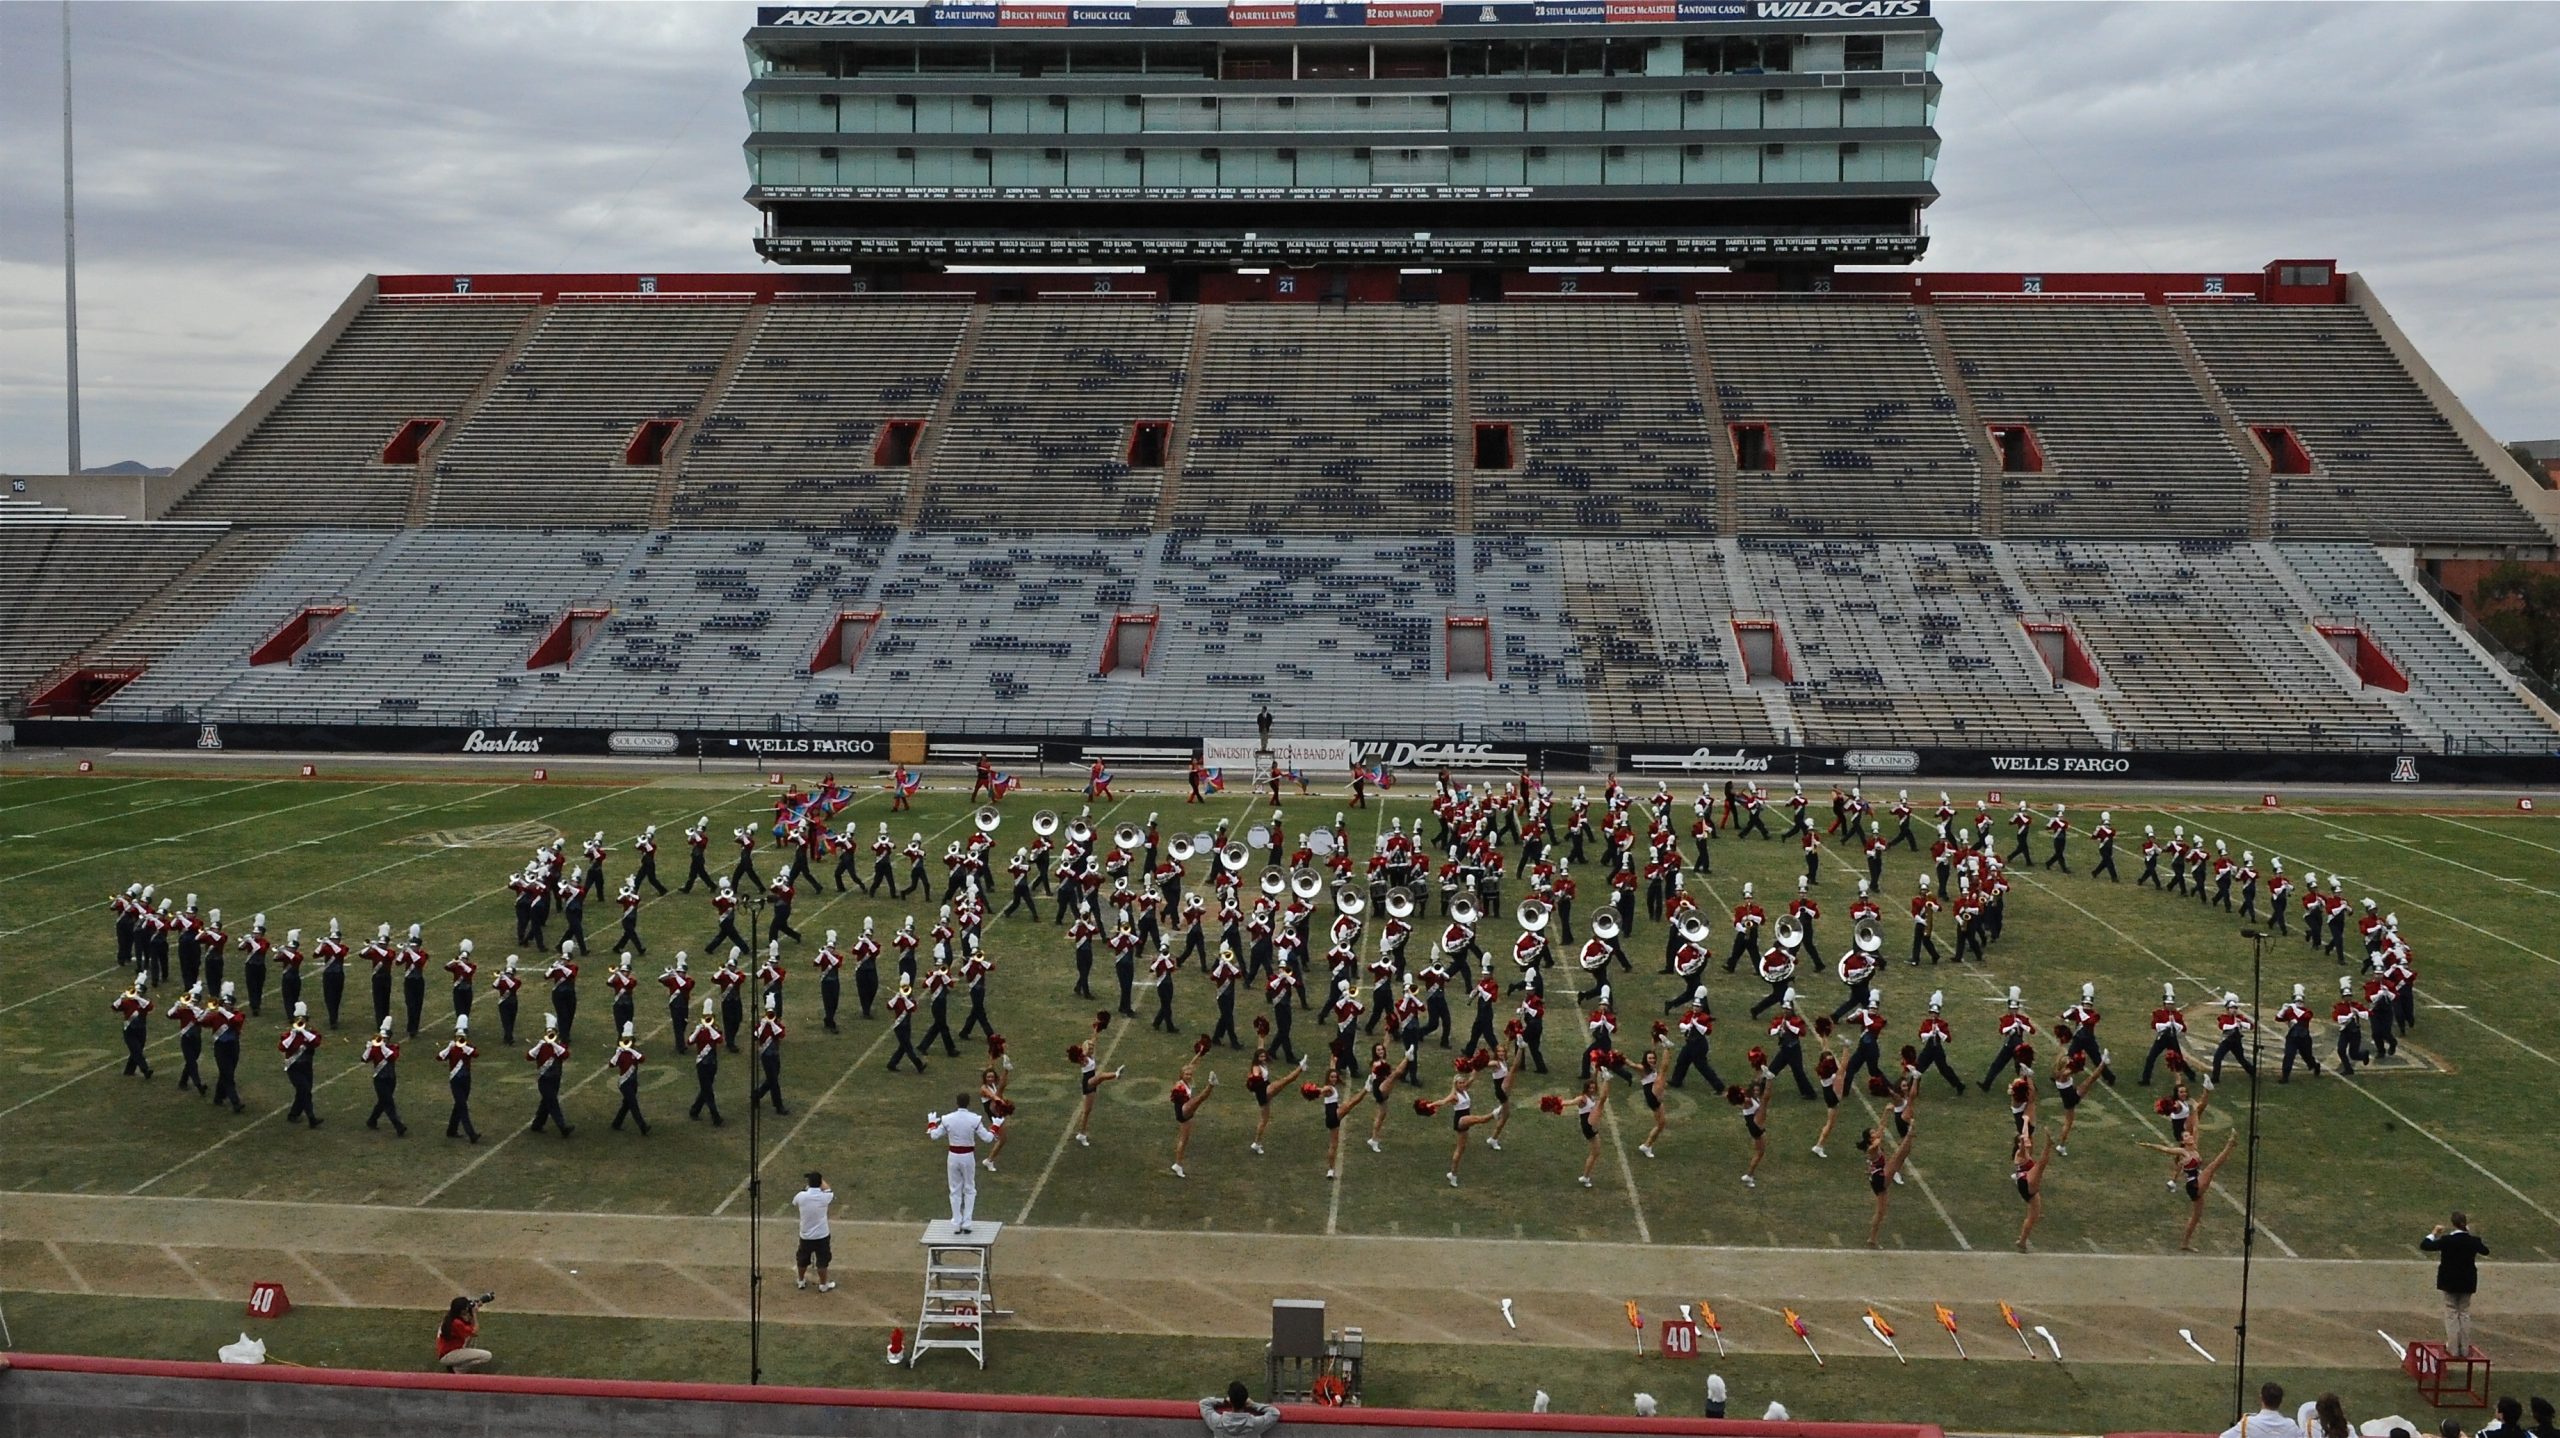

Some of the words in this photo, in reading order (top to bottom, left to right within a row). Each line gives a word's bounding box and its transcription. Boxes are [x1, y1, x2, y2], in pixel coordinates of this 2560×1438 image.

[1366, 9, 1377, 18] 92
[1377, 10, 1394, 18] ROB
[1396, 9, 1434, 18] WALDROP
[1535, 6, 1545, 15] 28
[1546, 7, 1564, 15] STEVE
[1565, 7, 1605, 15] McLAUGHLIN
[1614, 6, 1636, 15] CHRIS
[1637, 6, 1675, 14] McALISTER
[1677, 5, 1683, 14] 5
[1683, 5, 1717, 14] ANTOINE
[1719, 5, 1746, 13] CASON
[1757, 1, 1921, 18] WILDCATS
[773, 10, 916, 26] ARIZONA
[935, 10, 944, 19] 22
[945, 11, 961, 20] ART
[962, 11, 995, 20] LUPPINO
[1001, 10, 1011, 20] 89
[1011, 11, 1034, 20] RICKY
[1036, 11, 1066, 20] HUNLEY
[1073, 10, 1079, 19] 6
[1080, 11, 1107, 20] CHUCK
[1109, 11, 1131, 20] CECIL
[1229, 12, 1234, 20] 4
[1236, 12, 1270, 20] DARRYLL
[1272, 12, 1296, 20] LEWIS
[456, 283, 469, 293] 17
[640, 282, 655, 292] 18
[853, 282, 866, 292] 19
[1094, 282, 1111, 292] 20
[1280, 281, 1294, 292] 21
[1561, 282, 1577, 292] 22
[1814, 282, 1831, 292] 23
[2024, 282, 2041, 293] 24
[2205, 282, 2222, 293] 25
[13, 480, 25, 490] 16
[462, 731, 543, 753] Bashas'
[615, 737, 631, 745] SOL
[633, 737, 672, 745] CASINOS
[745, 739, 809, 753] WELLS
[812, 740, 874, 753] FARGO
[1207, 748, 1251, 759] UNIVERSITY
[1304, 748, 1327, 760] BAND
[1329, 749, 1345, 760] DAY
[1850, 755, 1867, 765] SOL
[1871, 756, 1912, 765] CASINOS
[1991, 757, 2060, 771] WELLS
[2064, 758, 2130, 772] FARGO
[251, 1287, 274, 1312] 40
[955, 1307, 973, 1327] 50
[1667, 1327, 1690, 1352] 40
